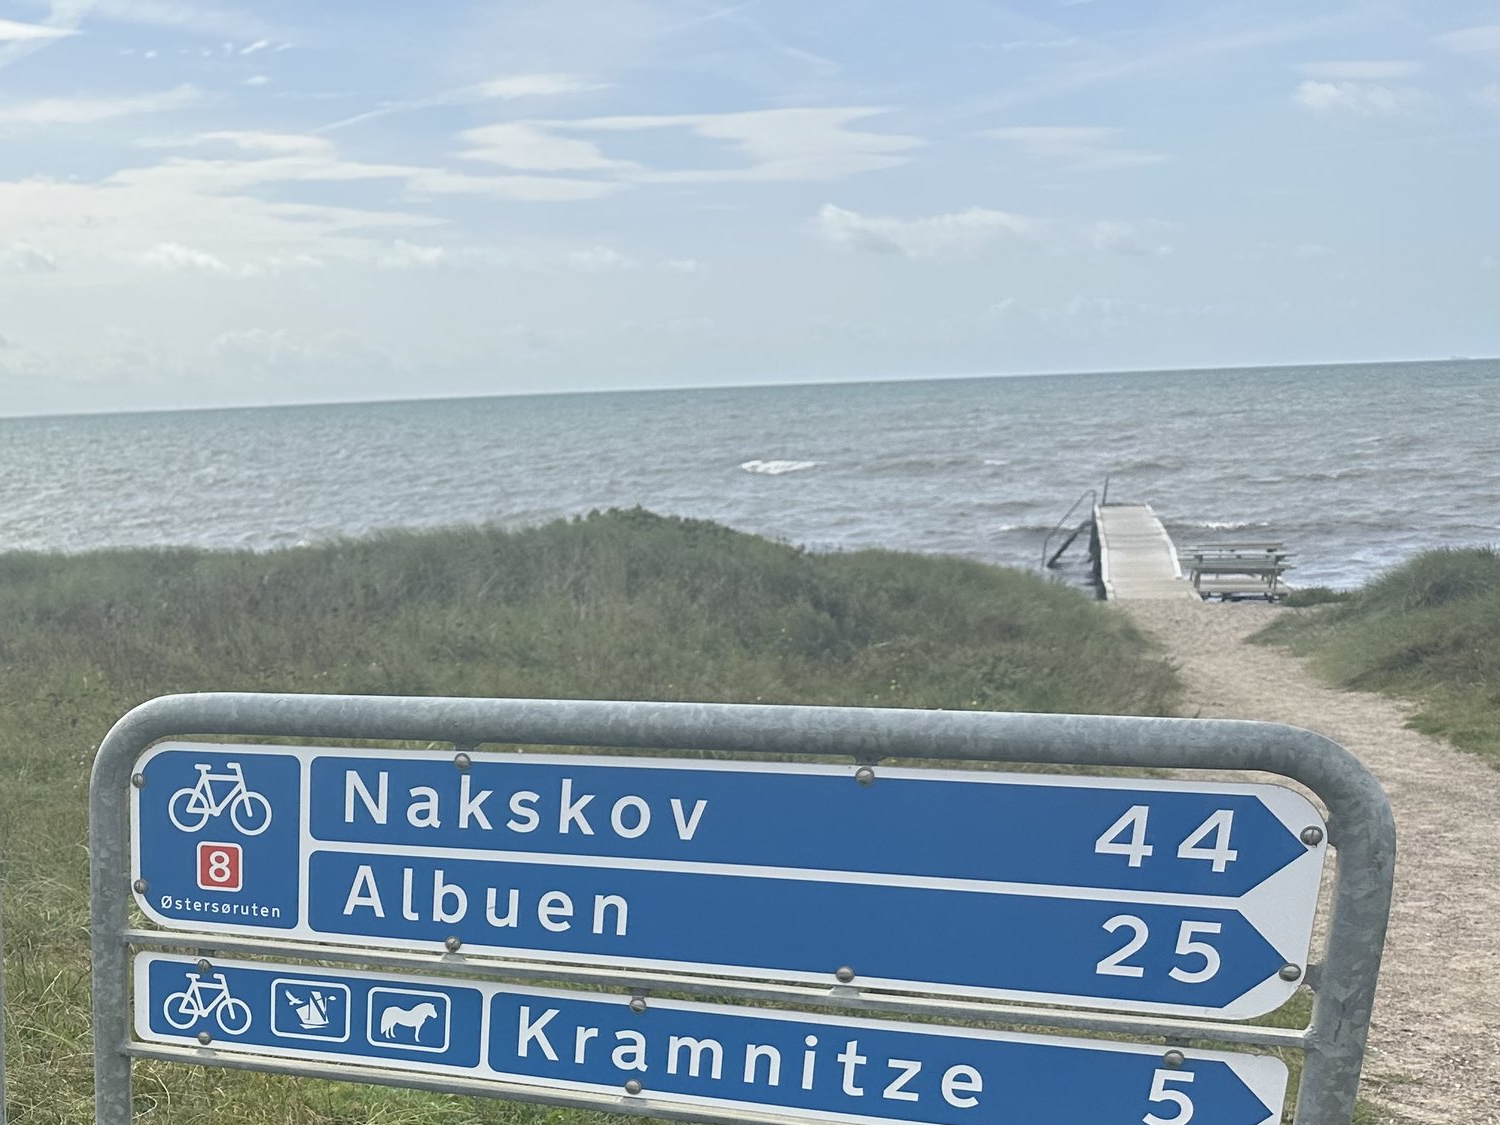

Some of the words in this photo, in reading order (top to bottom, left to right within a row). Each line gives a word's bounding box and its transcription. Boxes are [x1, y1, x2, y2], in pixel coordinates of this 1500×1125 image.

[208, 850, 231, 883] 8
[343, 770, 708, 842] Nakskov
[1093, 804, 1238, 873] 44
[160, 895, 281, 918] Østersøruten
[342, 864, 629, 937] Albuen
[1094, 914, 1222, 984] 25
[516, 1005, 985, 1109] Kramnitze
